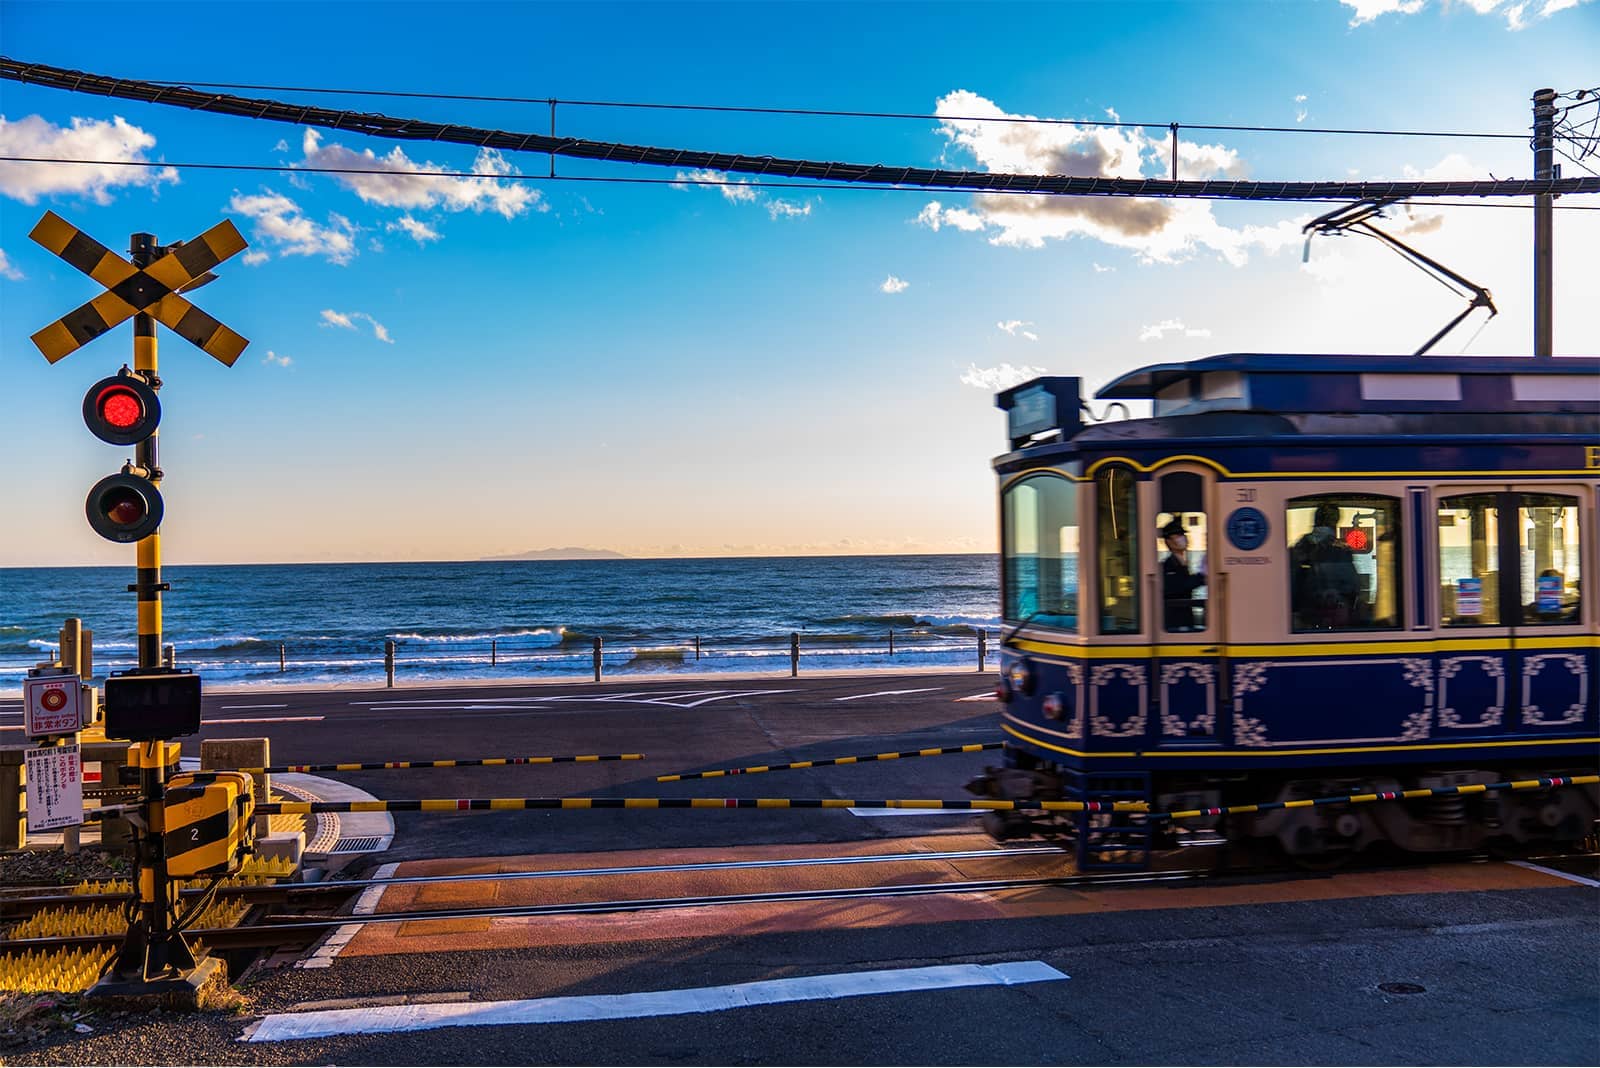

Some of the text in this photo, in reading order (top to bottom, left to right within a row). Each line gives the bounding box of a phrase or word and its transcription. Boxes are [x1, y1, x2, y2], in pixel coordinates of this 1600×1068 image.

[34, 718, 77, 730] 非常ボタン
[191, 828, 199, 841] 2
